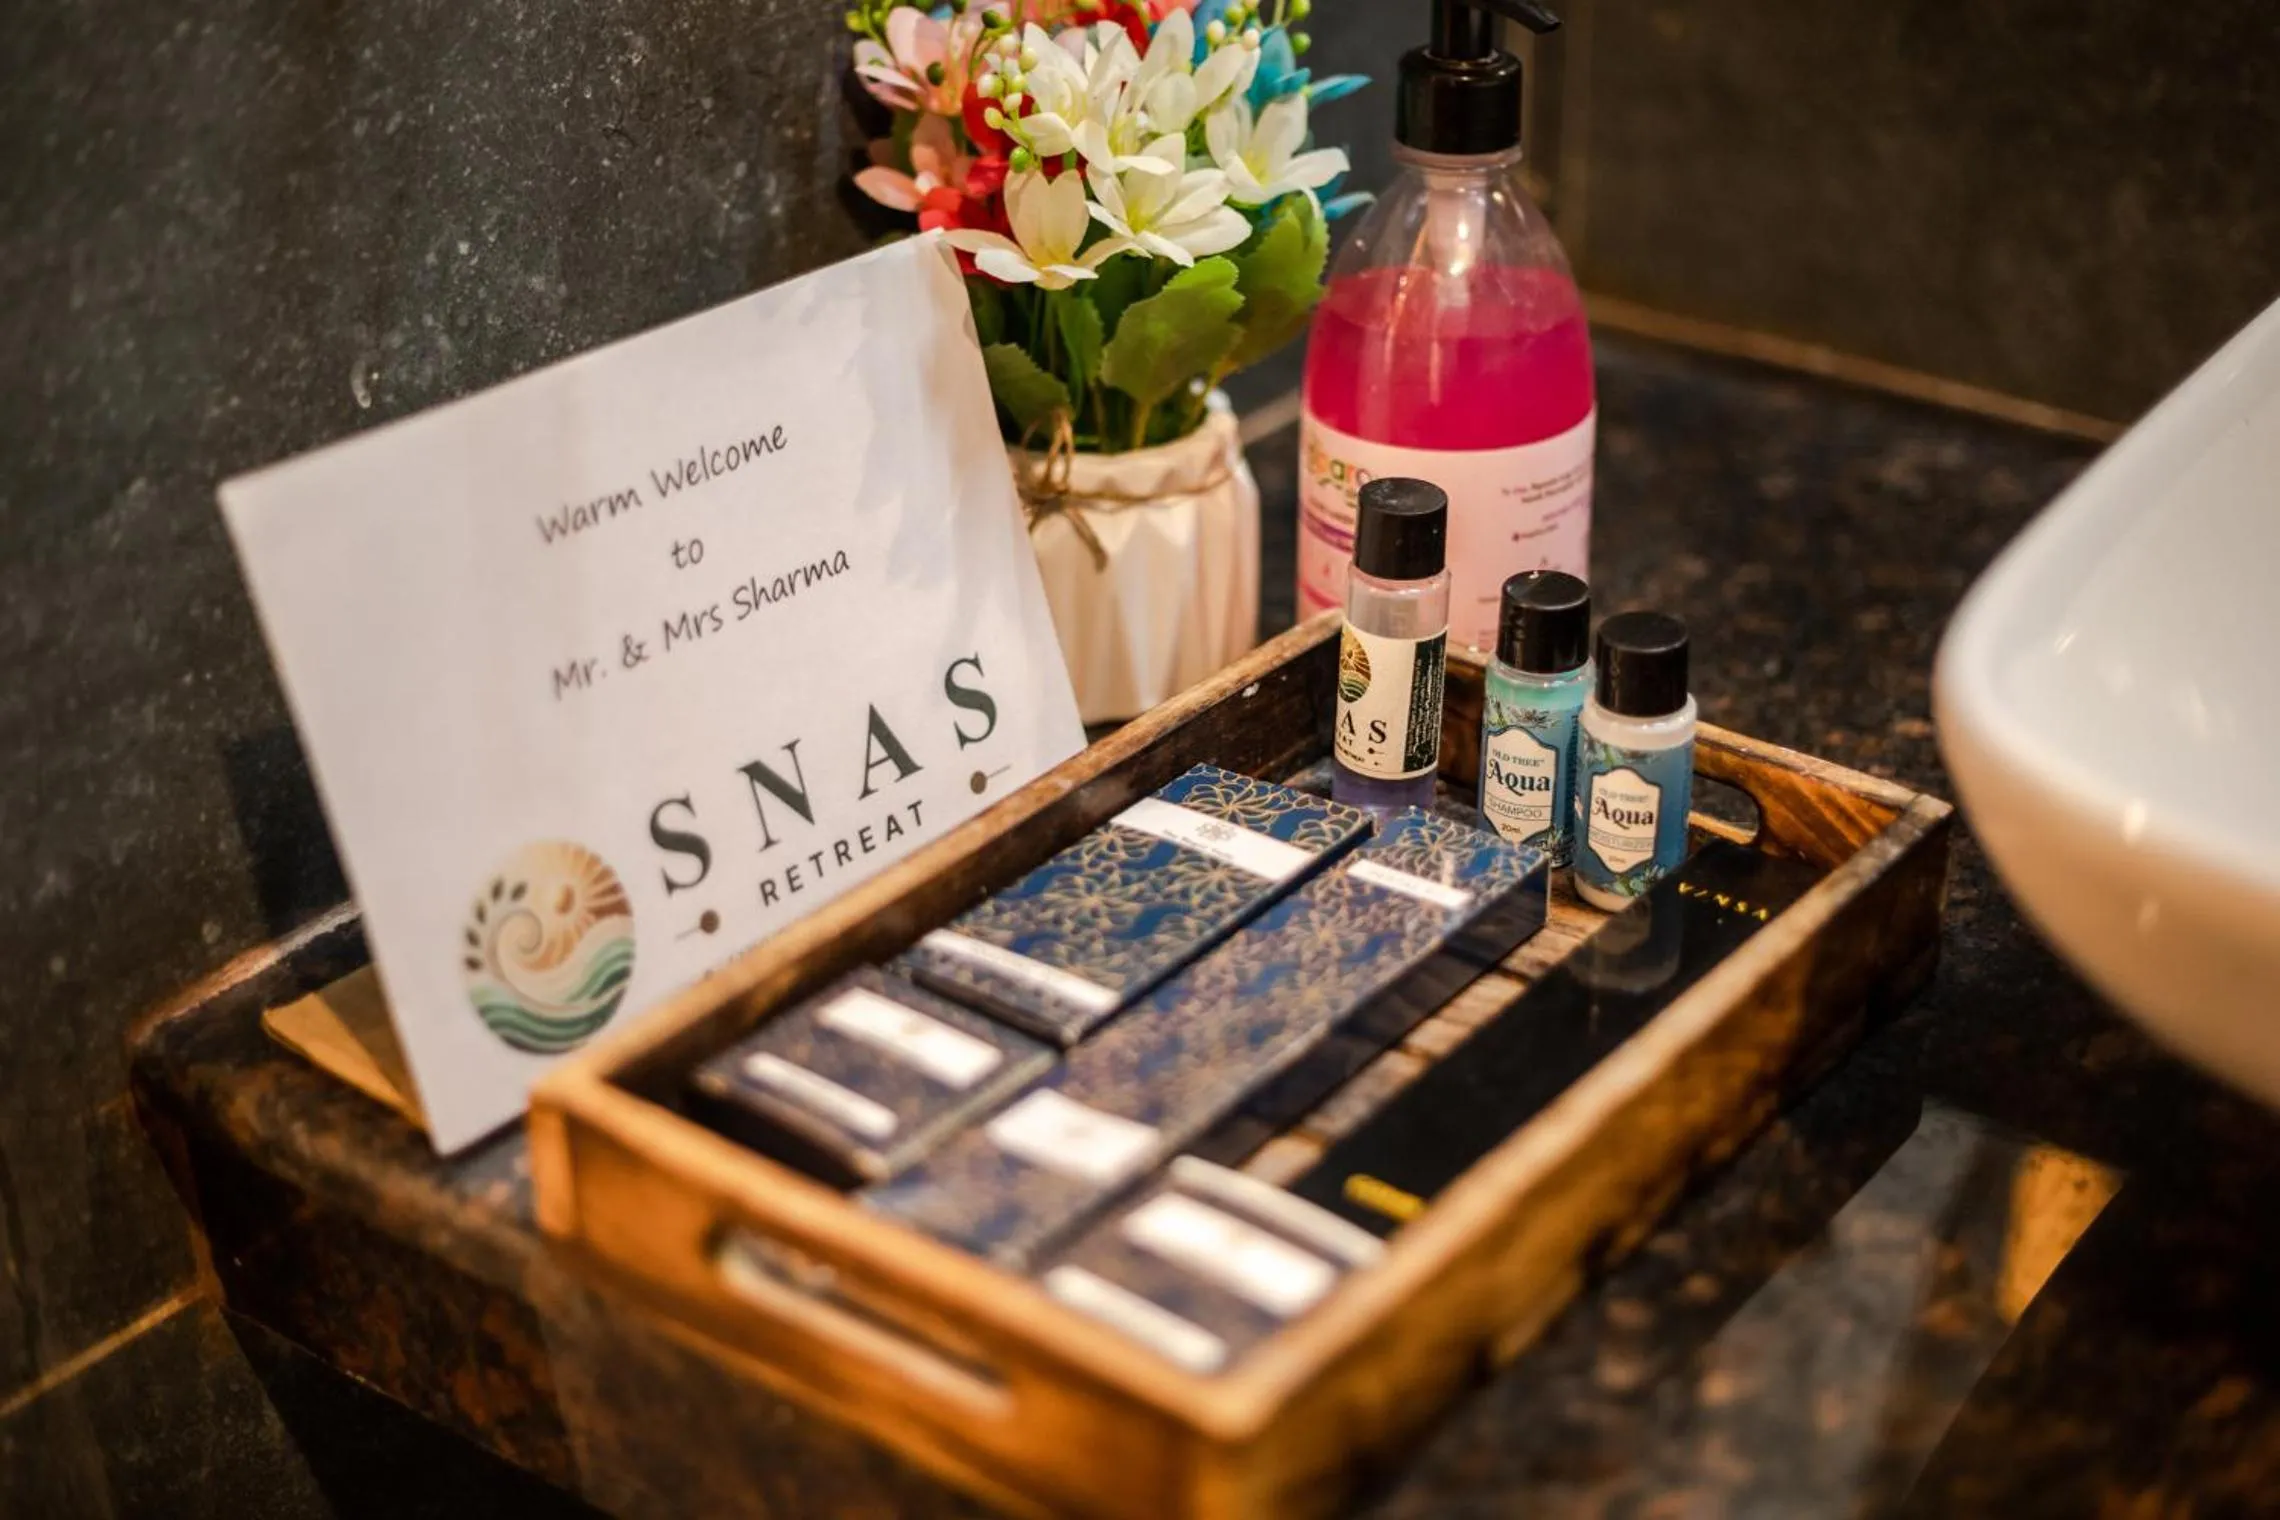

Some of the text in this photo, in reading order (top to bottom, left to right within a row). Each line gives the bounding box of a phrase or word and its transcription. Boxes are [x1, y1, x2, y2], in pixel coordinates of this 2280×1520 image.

[535, 424, 788, 545] Warm Welcome
[670, 537, 705, 571] to
[551, 549, 851, 702] Mr. & Mrs Sharma
[648, 651, 998, 897] SNAS
[1487, 758, 1551, 797] Aqua
[1591, 795, 1654, 830] Aqua
[759, 800, 925, 907] RETREAT
